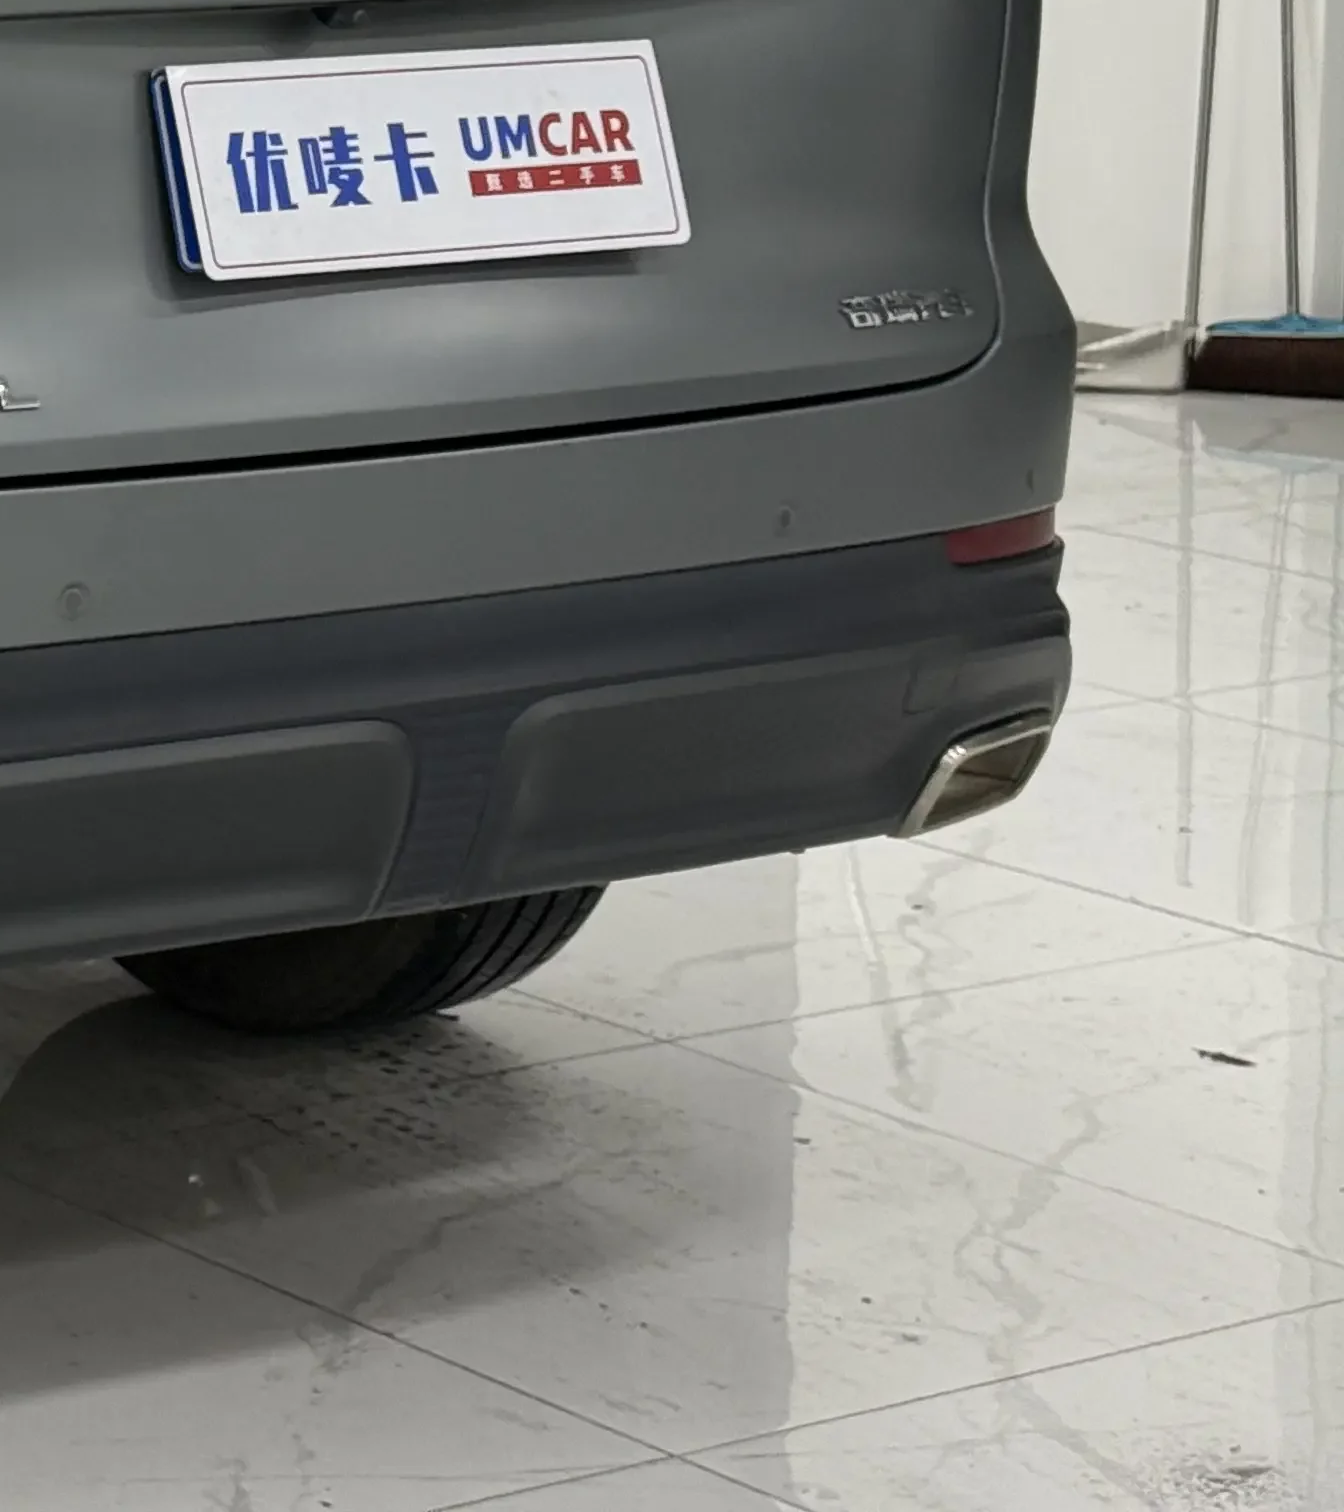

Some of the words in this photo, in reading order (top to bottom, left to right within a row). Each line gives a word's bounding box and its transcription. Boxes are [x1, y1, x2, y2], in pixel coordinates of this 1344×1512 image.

[226, 122, 439, 214] 优唛卡
[458, 109, 636, 162] UMCAR
